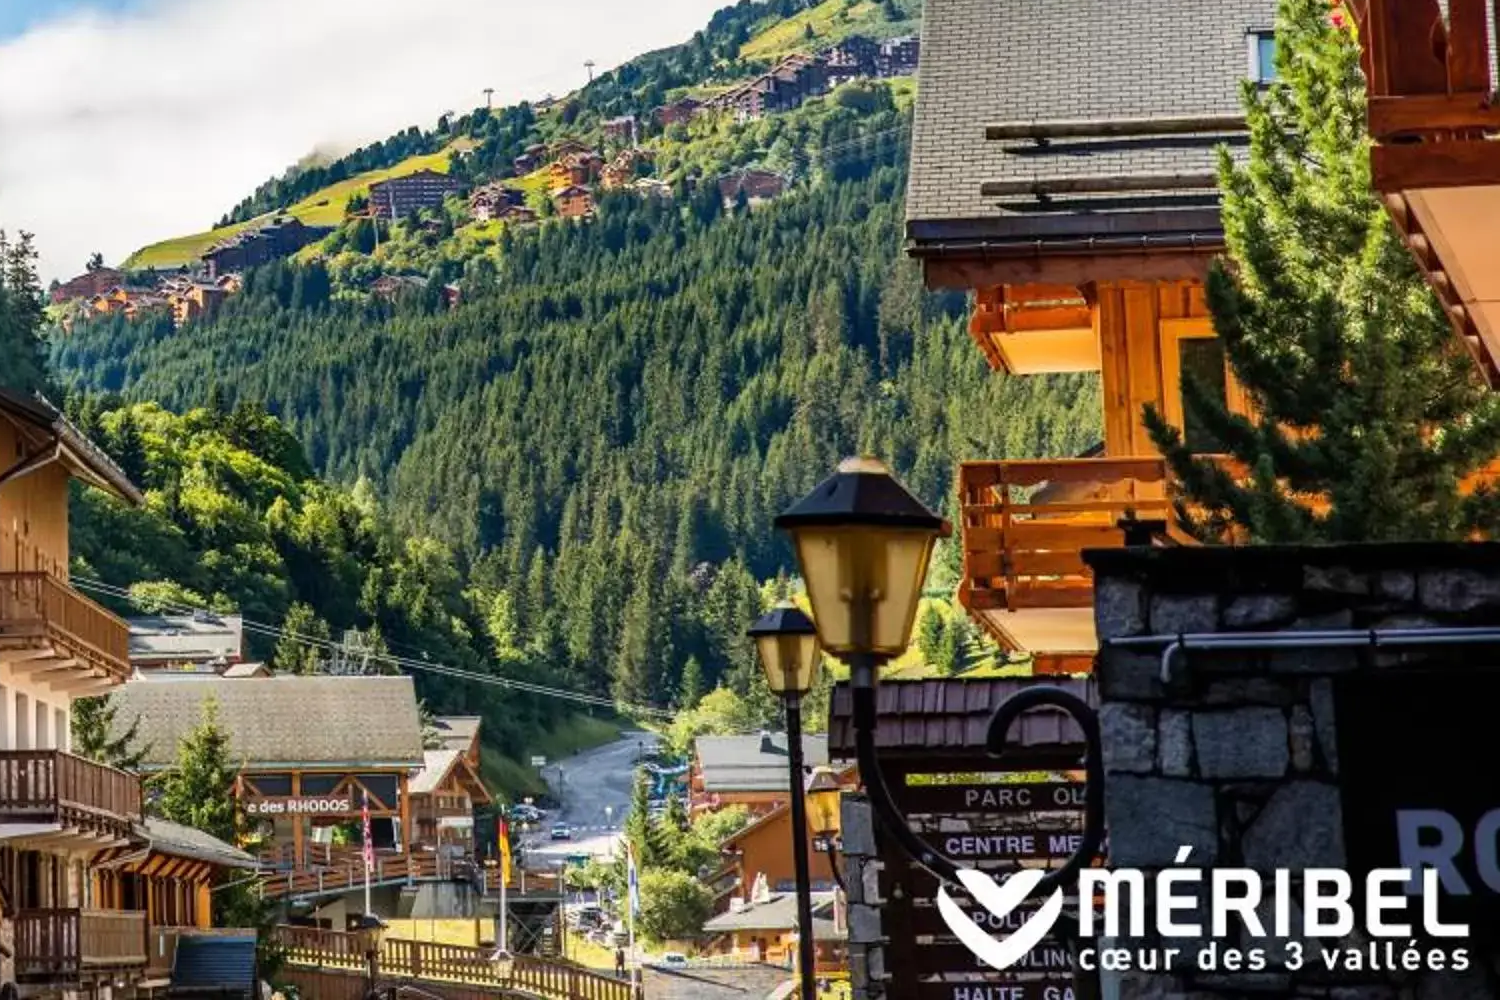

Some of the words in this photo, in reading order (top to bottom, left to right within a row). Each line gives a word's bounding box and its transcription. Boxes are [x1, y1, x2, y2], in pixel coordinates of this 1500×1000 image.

[260, 800, 285, 813] des
[287, 799, 350, 813] RHODOS
[965, 788, 1032, 807] PARC
[945, 835, 1035, 854] CENTRE
